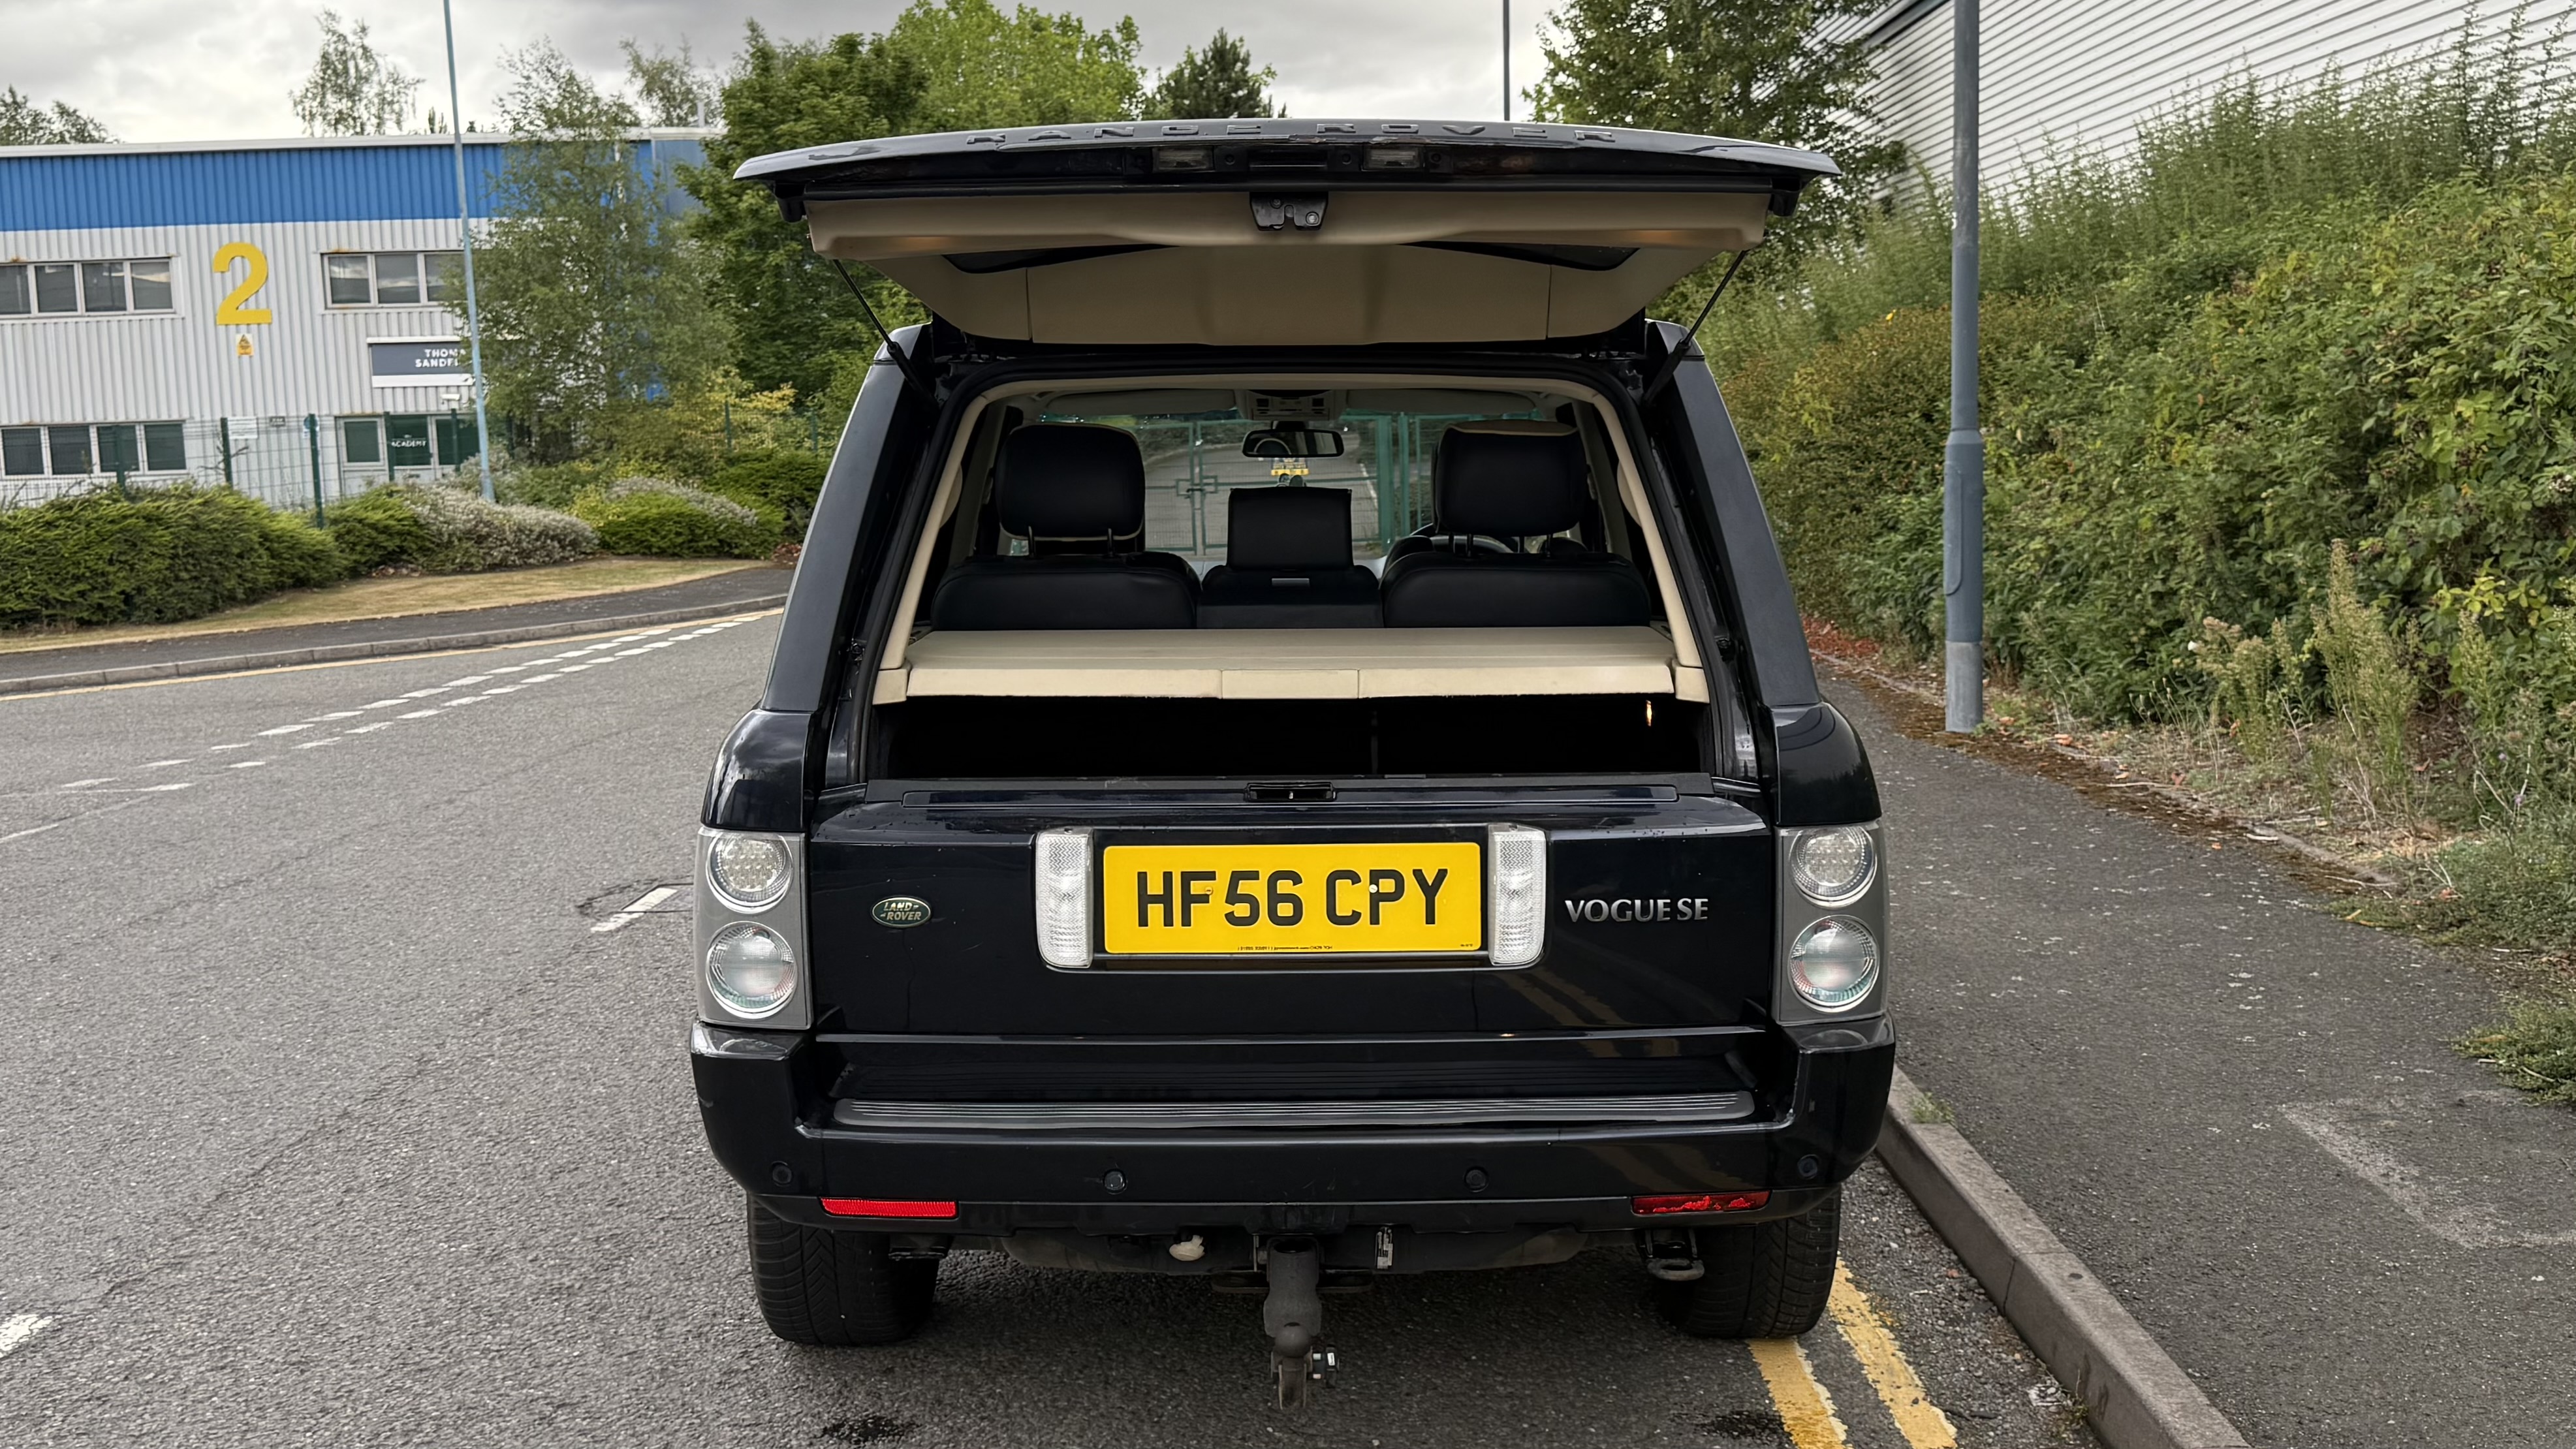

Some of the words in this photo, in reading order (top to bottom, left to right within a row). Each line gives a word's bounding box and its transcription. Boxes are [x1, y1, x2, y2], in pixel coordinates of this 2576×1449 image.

[213, 242, 273, 325] 2
[883, 902, 913, 911] LAND
[1137, 870, 1303, 927] HF56
[1326, 868, 1449, 926] CPY
[1565, 899, 1671, 922] VOGUE
[1676, 897, 1708, 921] SE
[887, 911, 922, 920] ROVER
